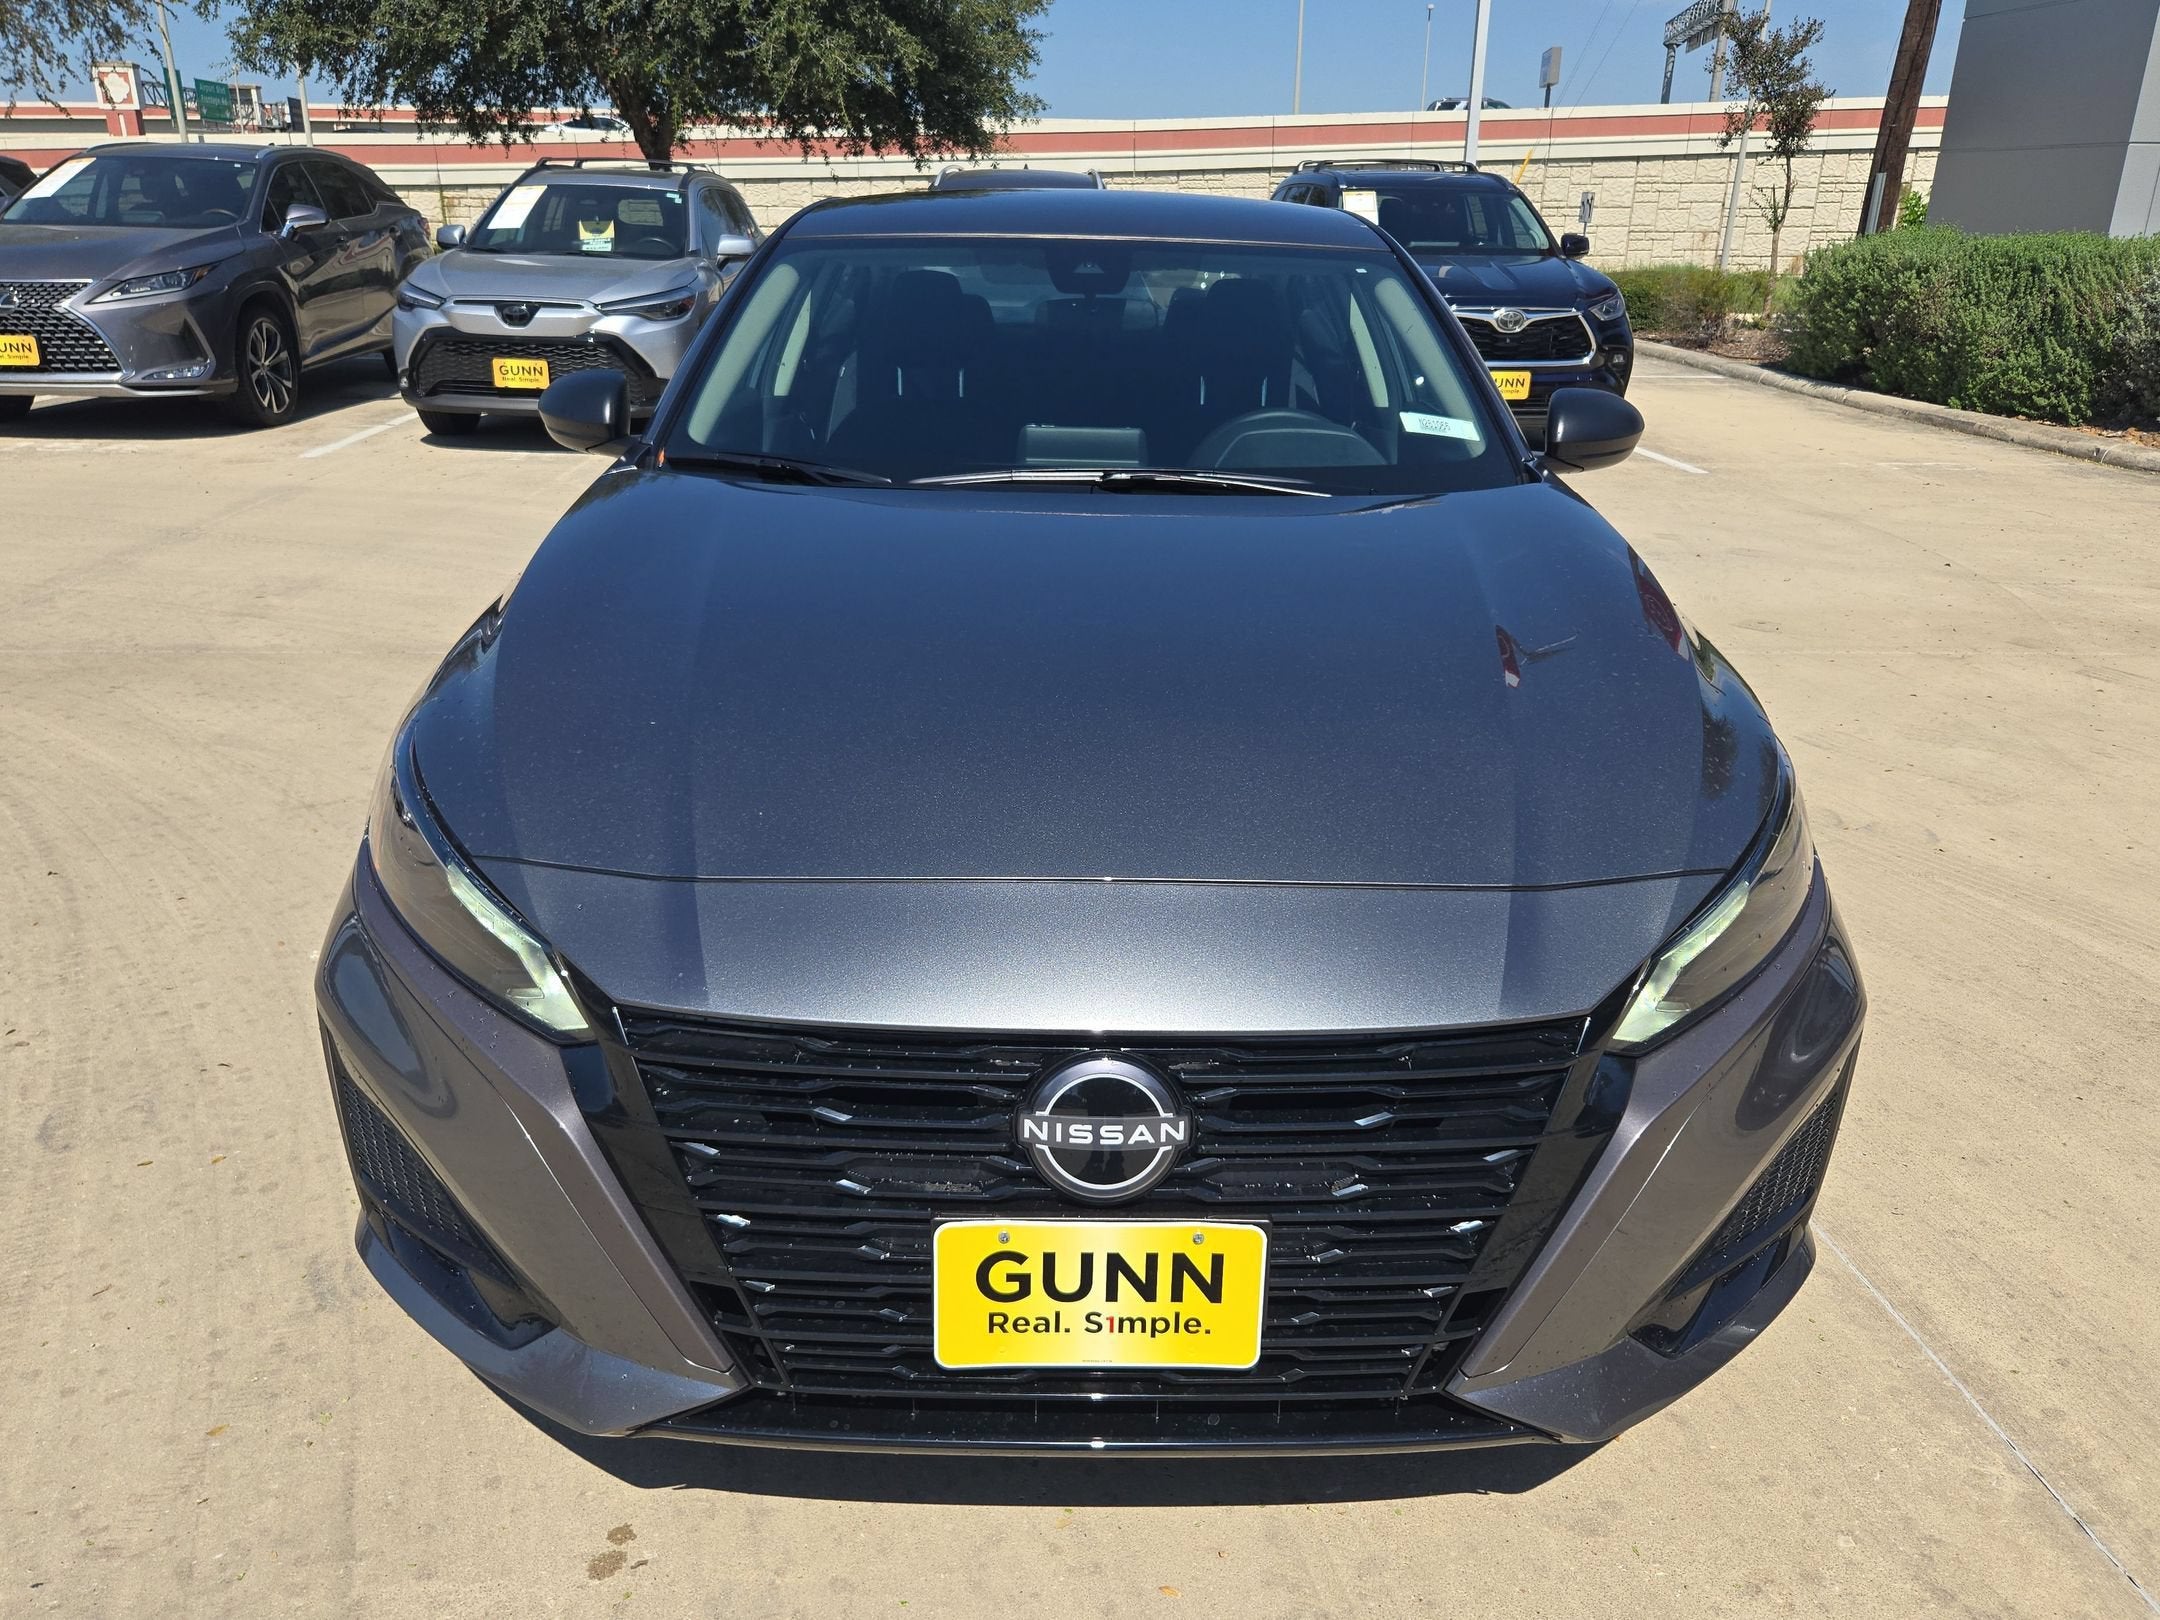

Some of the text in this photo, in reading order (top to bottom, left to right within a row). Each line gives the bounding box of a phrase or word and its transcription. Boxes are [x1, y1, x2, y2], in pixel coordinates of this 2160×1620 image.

[0, 342, 32, 353] UNN
[499, 365, 543, 376] GUNN
[1495, 378, 1525, 388] UNN
[1023, 1118, 1185, 1145] NISSAN
[975, 1249, 1225, 1304] GUNN
[988, 1310, 1071, 1334] Real.
